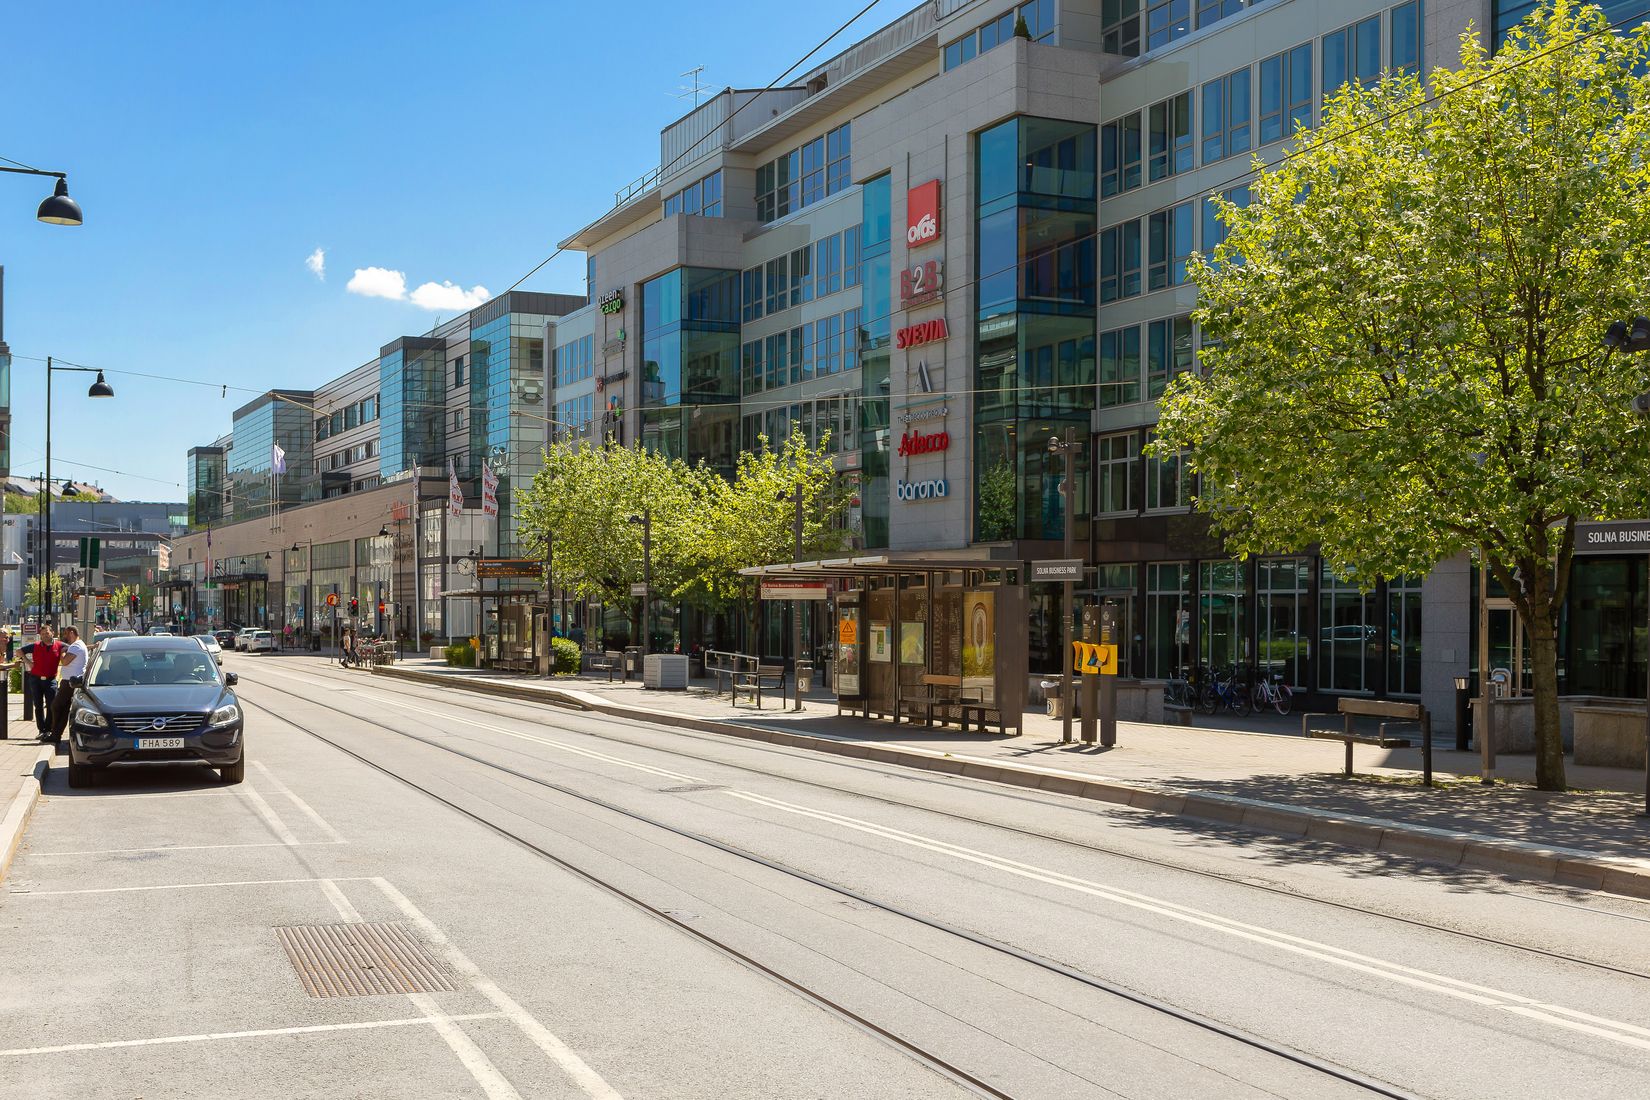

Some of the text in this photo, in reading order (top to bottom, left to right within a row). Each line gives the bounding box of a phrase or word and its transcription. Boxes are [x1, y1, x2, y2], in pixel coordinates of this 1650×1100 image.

[900, 260, 943, 299] B2B
[600, 299, 621, 315] cargo
[898, 430, 950, 457] Adecco
[896, 479, 949, 502] barona
[1588, 531, 1617, 543] SOLNA
[1036, 566, 1077, 575] SOLNA BUSINESS PARK
[142, 739, 181, 748] FHA 589
